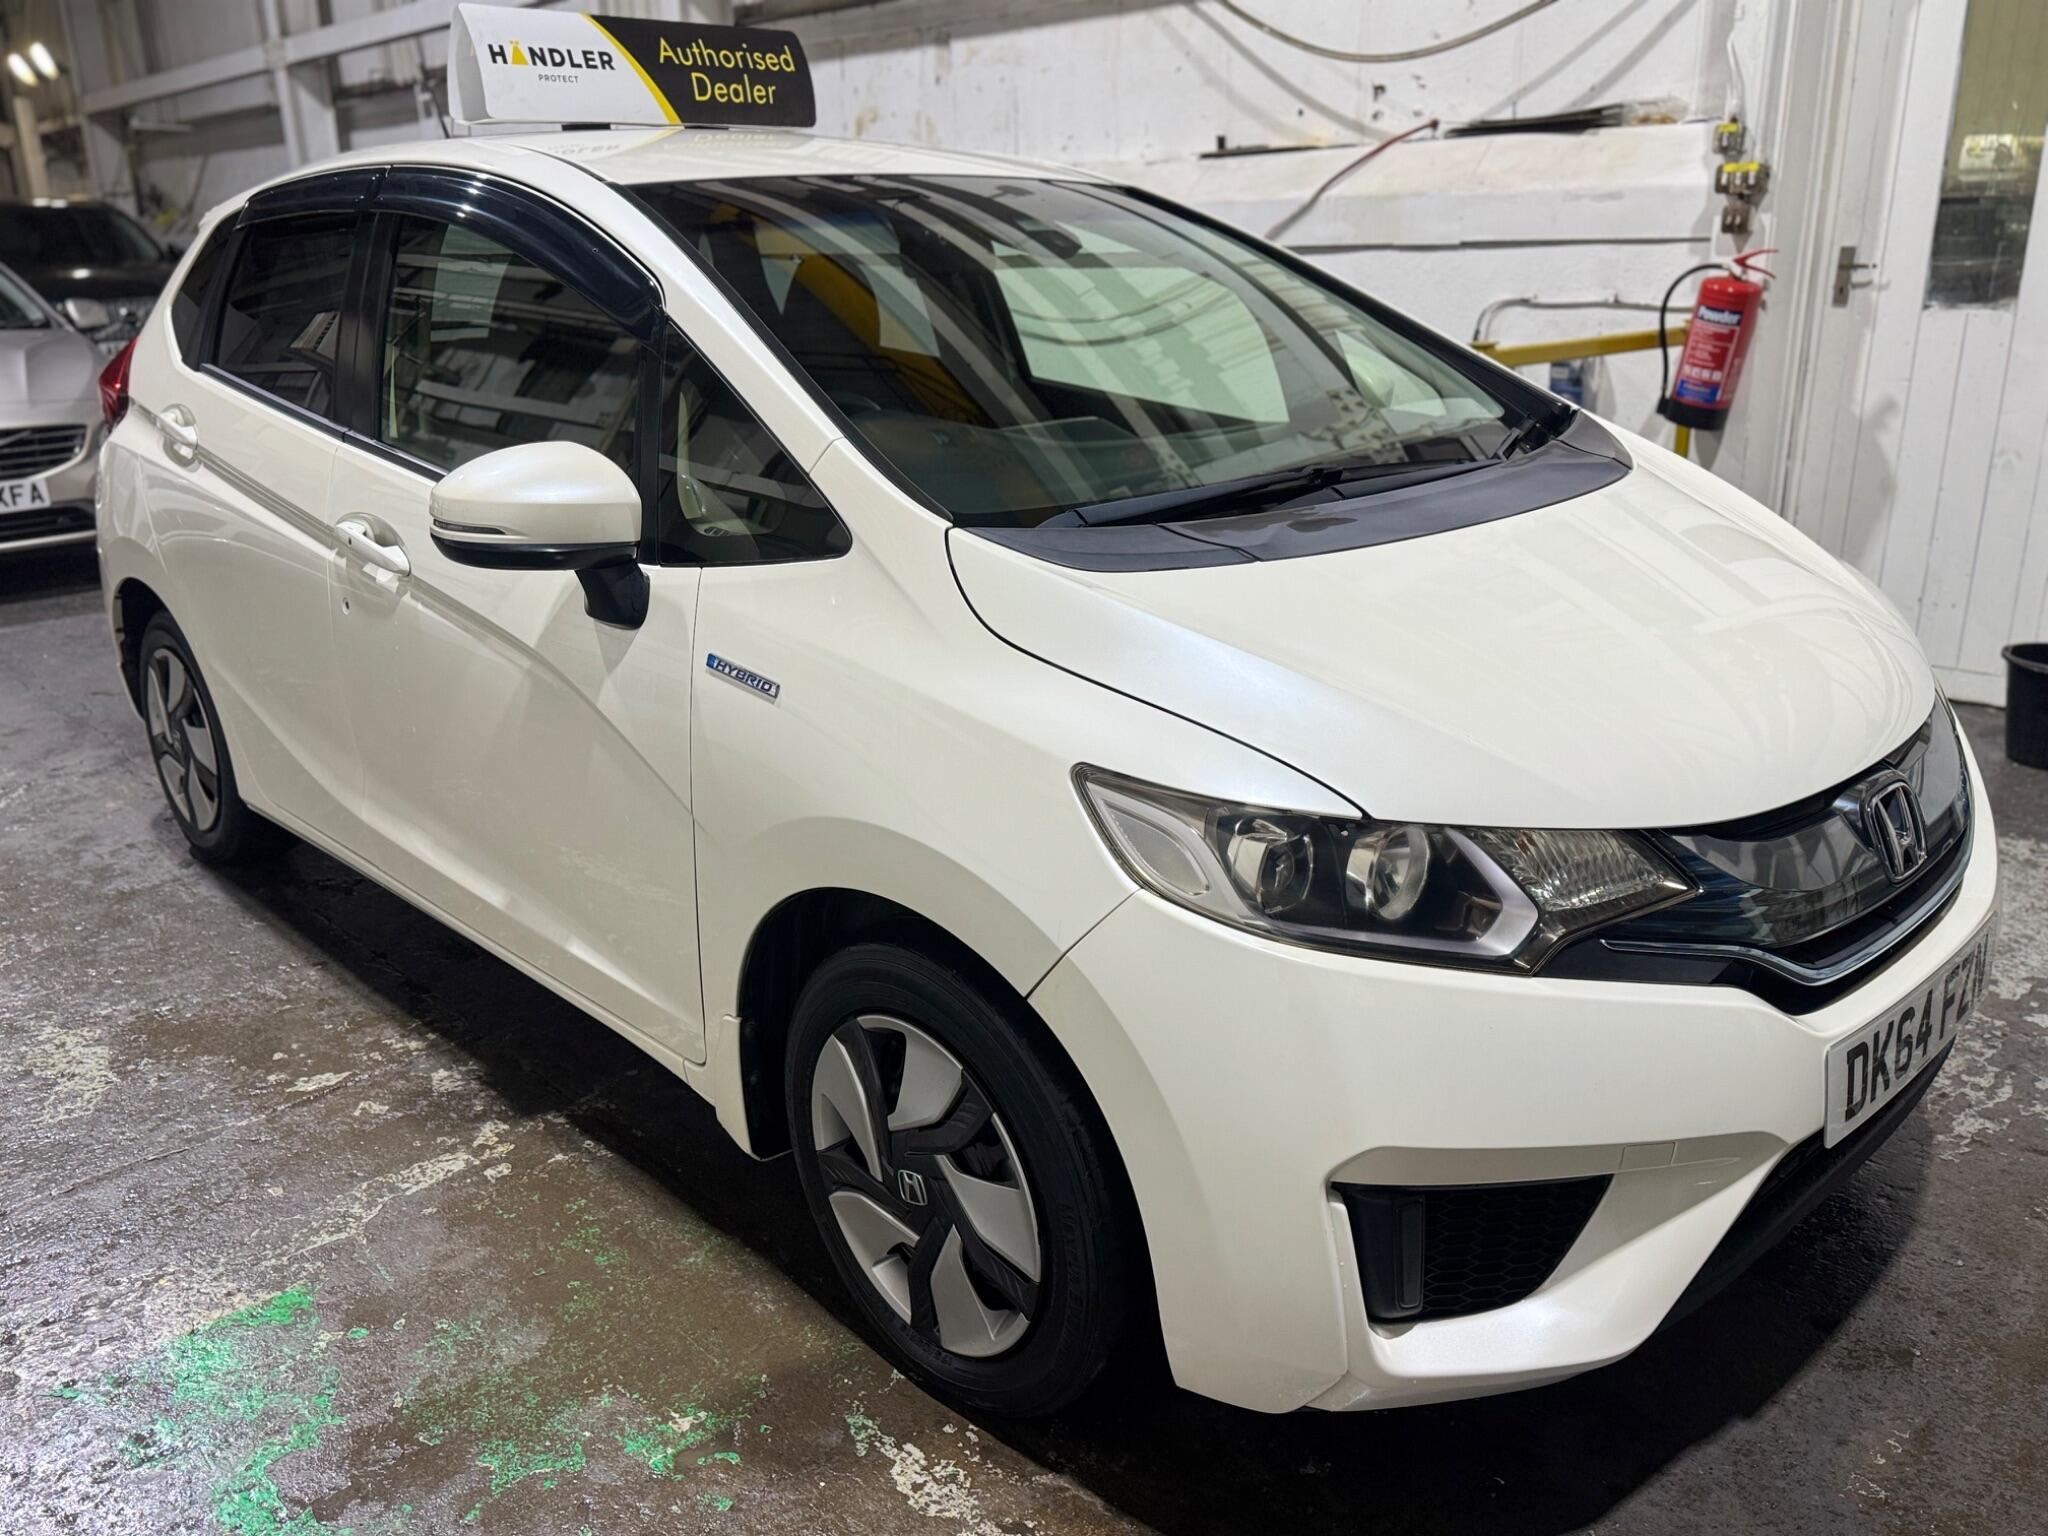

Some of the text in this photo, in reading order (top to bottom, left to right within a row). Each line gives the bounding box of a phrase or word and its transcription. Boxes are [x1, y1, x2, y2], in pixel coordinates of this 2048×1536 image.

[659, 36, 796, 72] Authorised
[538, 73, 579, 83] PROTECT
[691, 71, 776, 104] Dealer
[1697, 304, 1742, 325] Powder
[715, 659, 773, 693] HYBRID
[1845, 988, 1934, 1123] DK64
